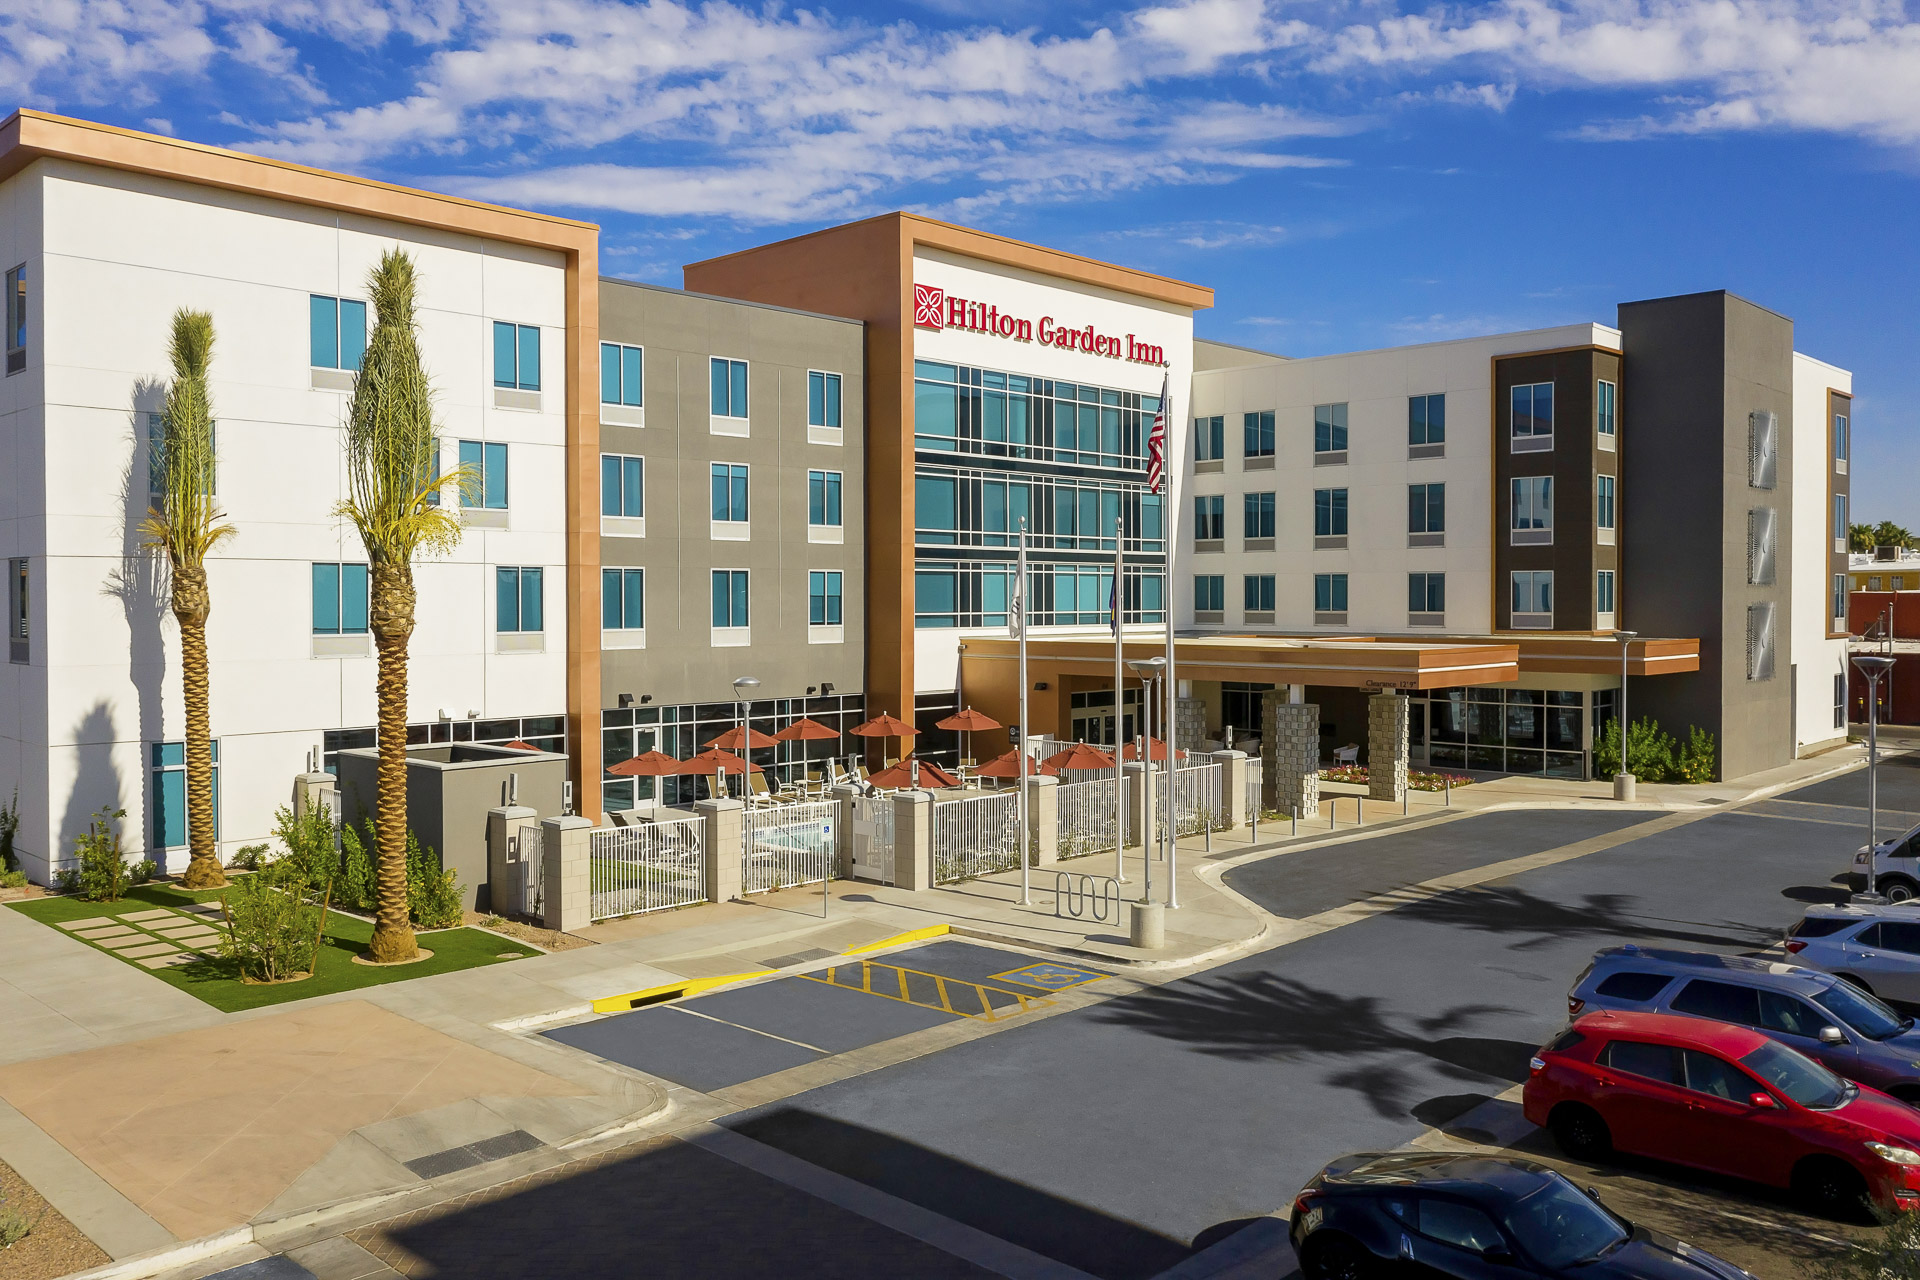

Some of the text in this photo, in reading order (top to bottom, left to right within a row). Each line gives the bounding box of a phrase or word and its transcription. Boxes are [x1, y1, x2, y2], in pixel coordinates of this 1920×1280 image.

[946, 296, 1163, 365] Hilton Garden Inn
[1365, 679, 1397, 688] Clearance
